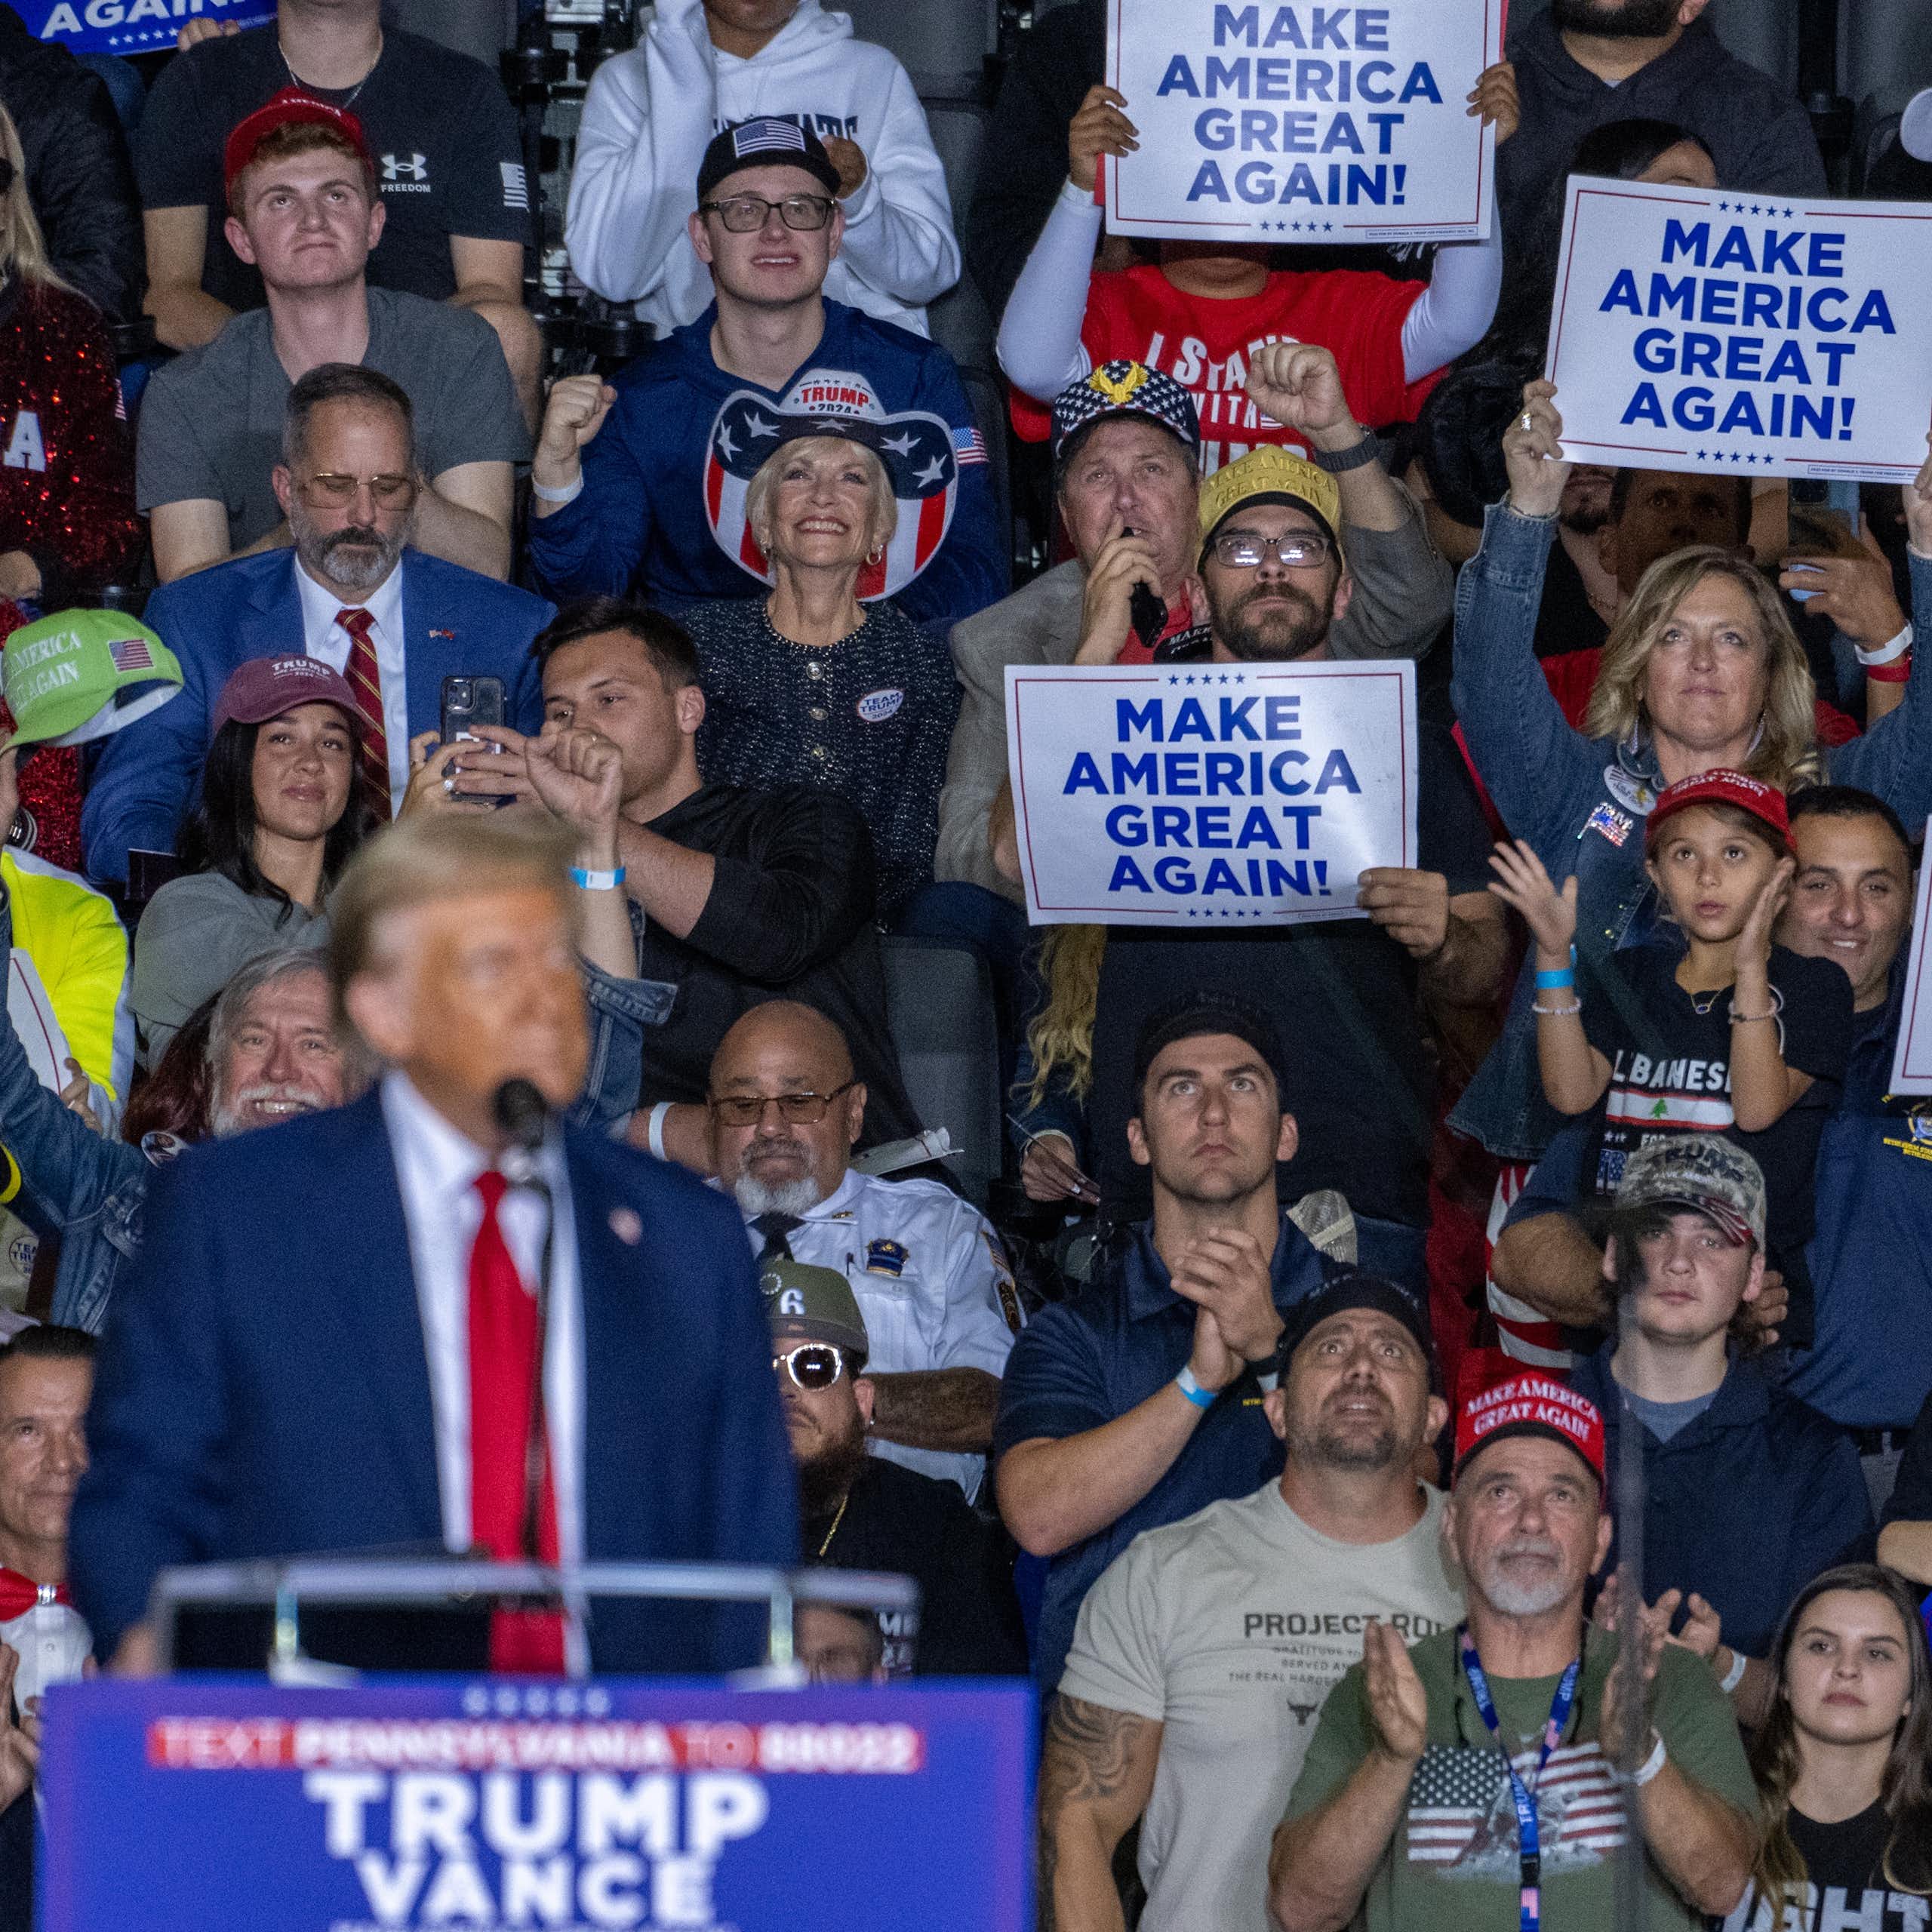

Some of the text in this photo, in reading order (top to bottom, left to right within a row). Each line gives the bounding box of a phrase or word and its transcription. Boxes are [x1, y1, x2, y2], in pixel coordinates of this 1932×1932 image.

[1214, 5, 1389, 51] MAKE
[1156, 55, 1443, 104] AMERICA
[1195, 108, 1404, 155] GREAT
[381, 183, 431, 193] FREEDOM
[1186, 160, 1407, 205] AGAIN!
[1661, 219, 1845, 278] MAKE
[1598, 269, 1896, 334] AMERICA
[1633, 328, 1856, 386] GREAT
[801, 386, 869, 408] TRUMP
[1620, 382, 1855, 441] AGAIN!
[272, 660, 330, 675] TRUMP
[864, 692, 900, 706] TEAM
[1116, 697, 1302, 743] MAKE
[1063, 749, 1361, 797] AMERICA
[1105, 804, 1322, 851] GREAT
[1107, 855, 1332, 898] AGAIN!
[1466, 1378, 1598, 1424] MAKE AMERICA
[1474, 1401, 1590, 1442] GREAT AGAIN
[1229, 1671, 1251, 1682] THE
[1281, 1660, 1327, 1670] SERVED
[162, 1719, 281, 1767] TEXT
[295, 1719, 670, 1770] PENNSYLVANIA
[685, 1721, 753, 1770] TO
[306, 1774, 768, 1858] TRUMP
[356, 1849, 715, 1926] VANCE
